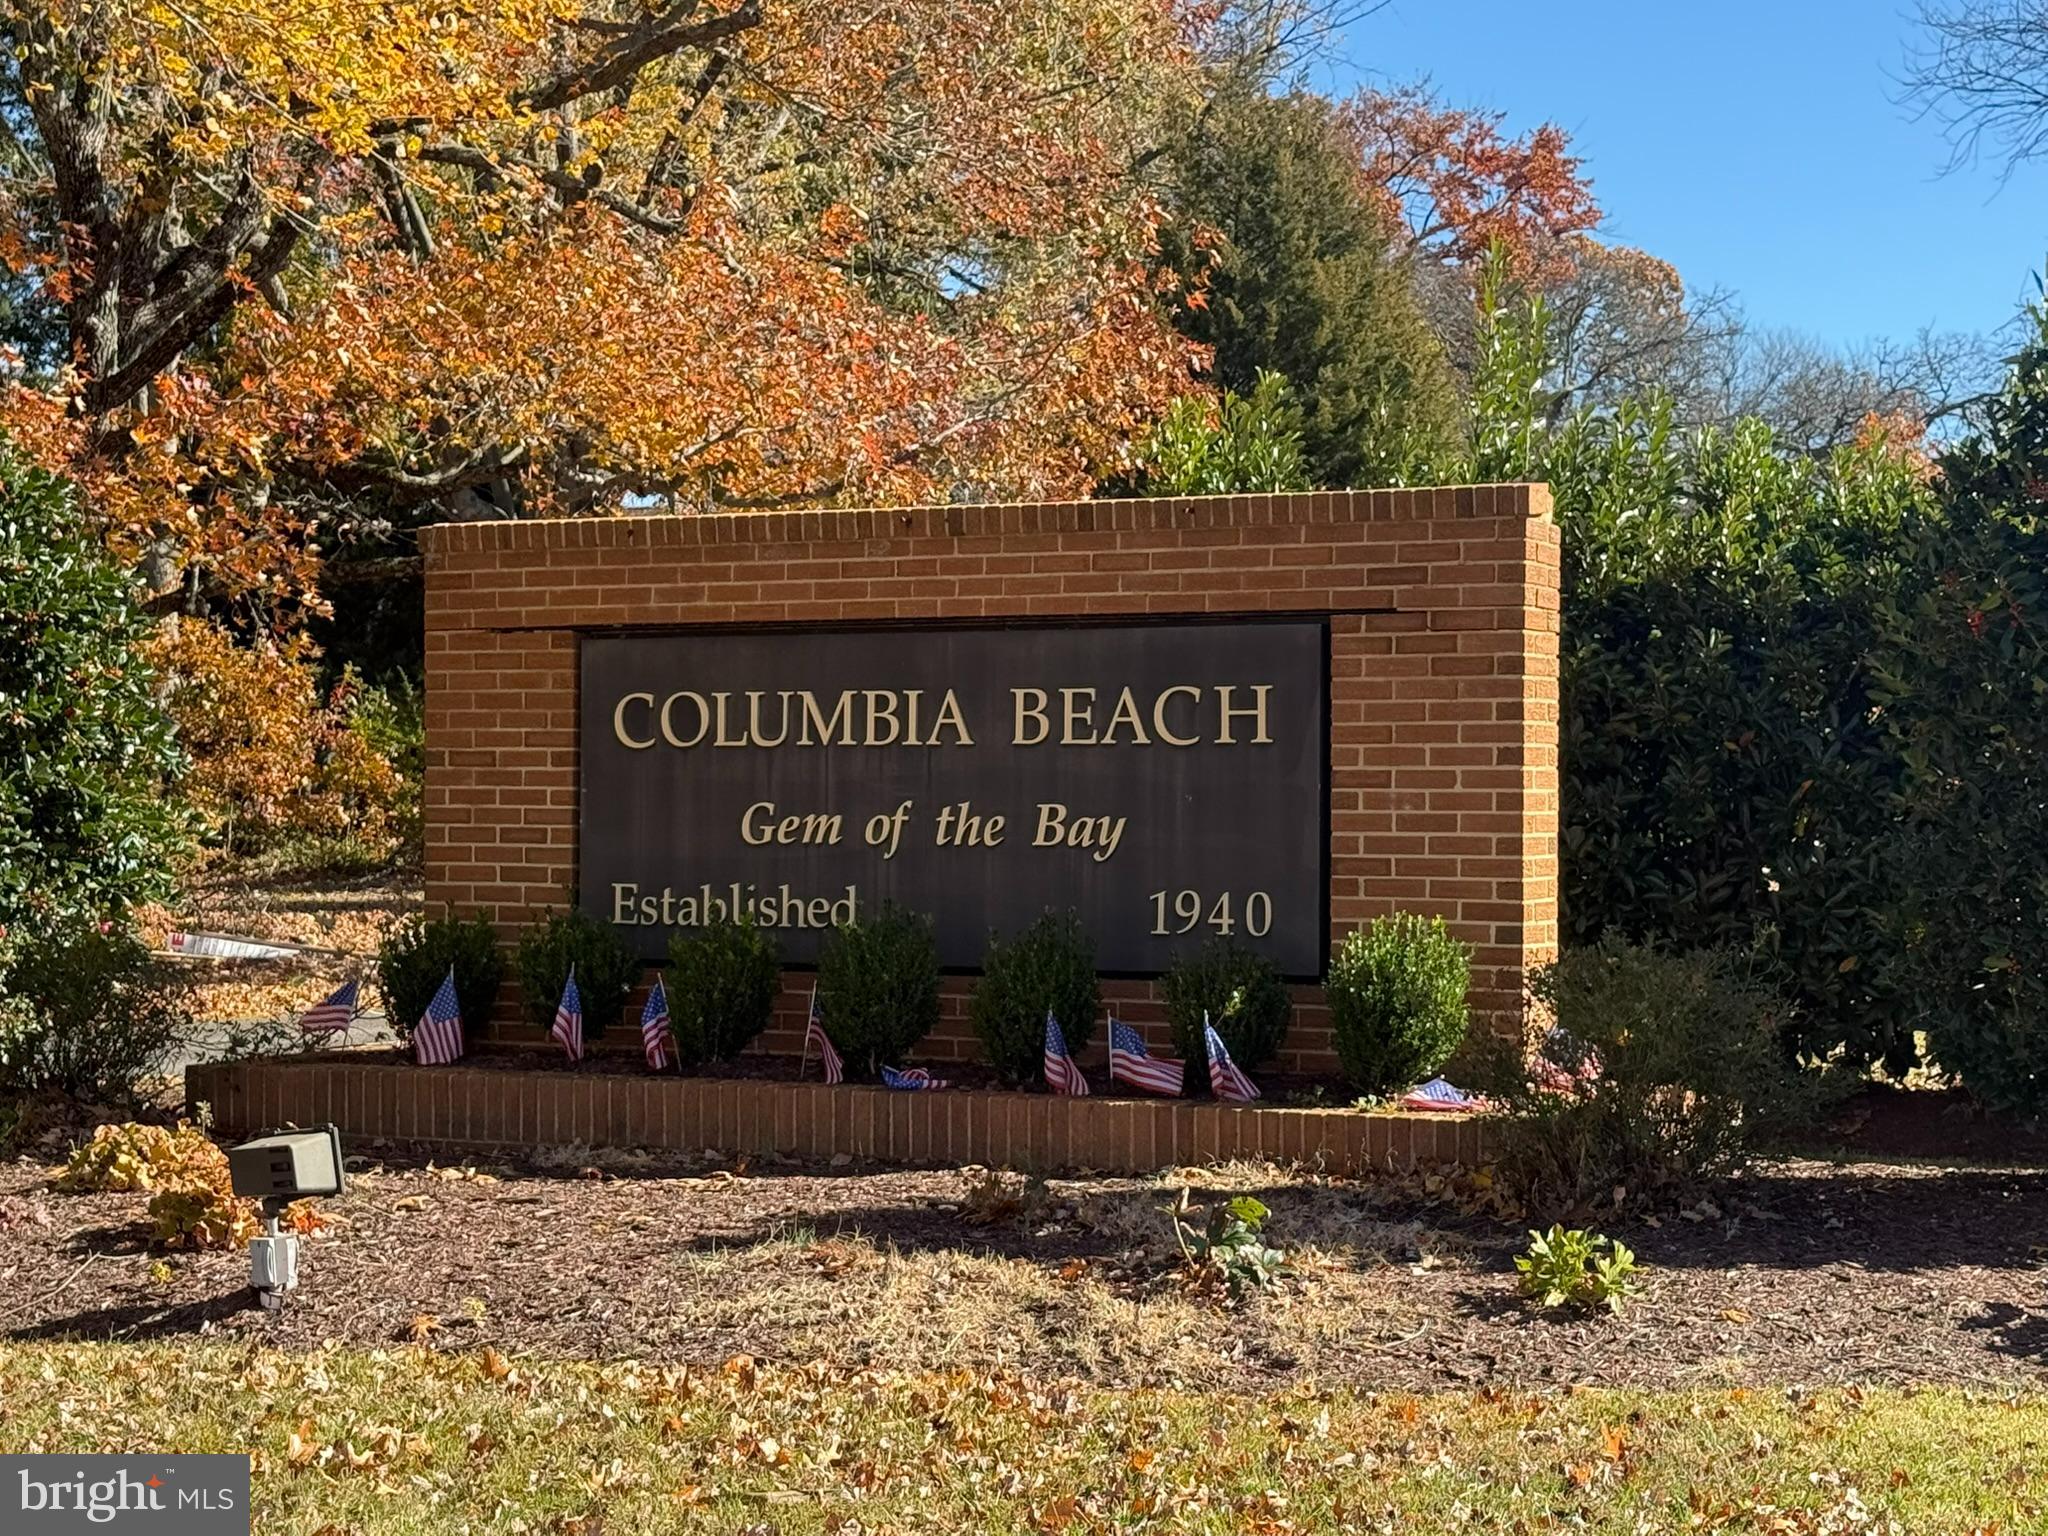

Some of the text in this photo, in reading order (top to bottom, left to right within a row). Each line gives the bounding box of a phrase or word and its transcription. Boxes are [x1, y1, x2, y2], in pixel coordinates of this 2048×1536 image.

[613, 684, 1274, 749] COLUMBIA BEACH
[741, 800, 1127, 862] Gem of the Bay
[611, 882, 1273, 937] Established 1940
